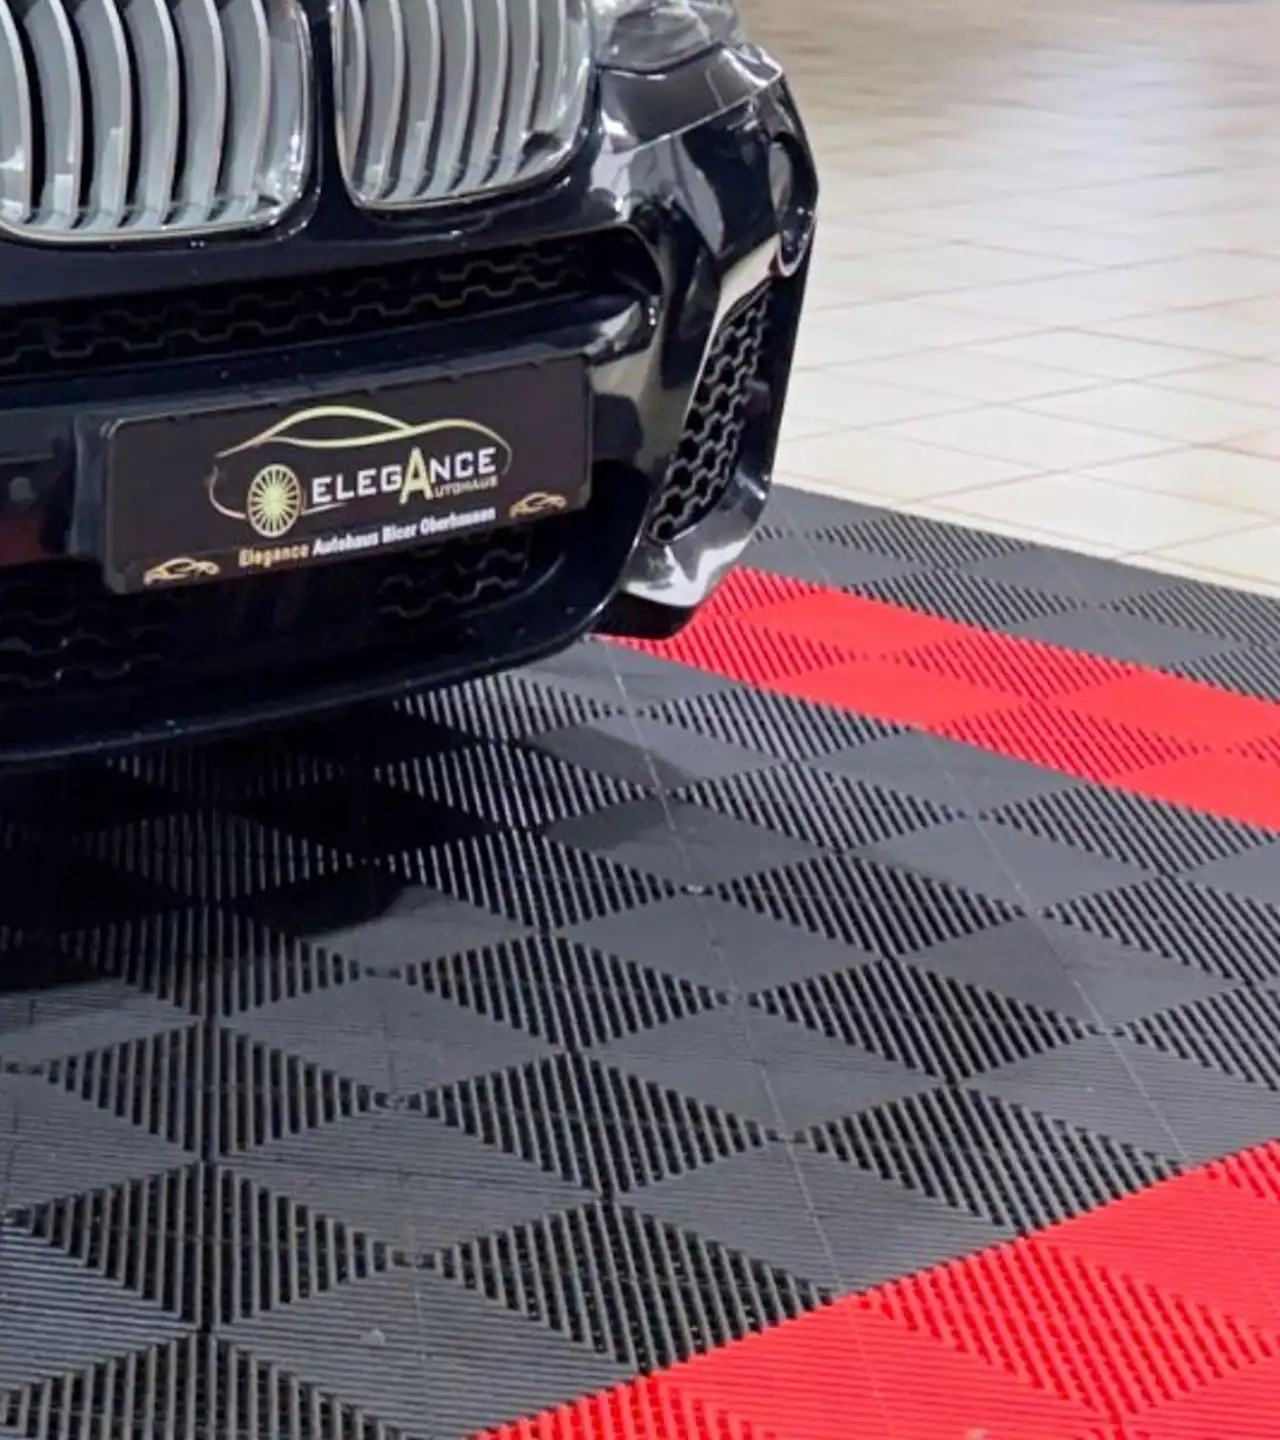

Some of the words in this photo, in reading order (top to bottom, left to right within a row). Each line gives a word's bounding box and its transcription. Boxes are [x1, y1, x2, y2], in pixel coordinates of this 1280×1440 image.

[311, 445, 498, 505] ELEGANCE
[239, 544, 310, 567] Elegance
[313, 531, 380, 557] Autohaus
